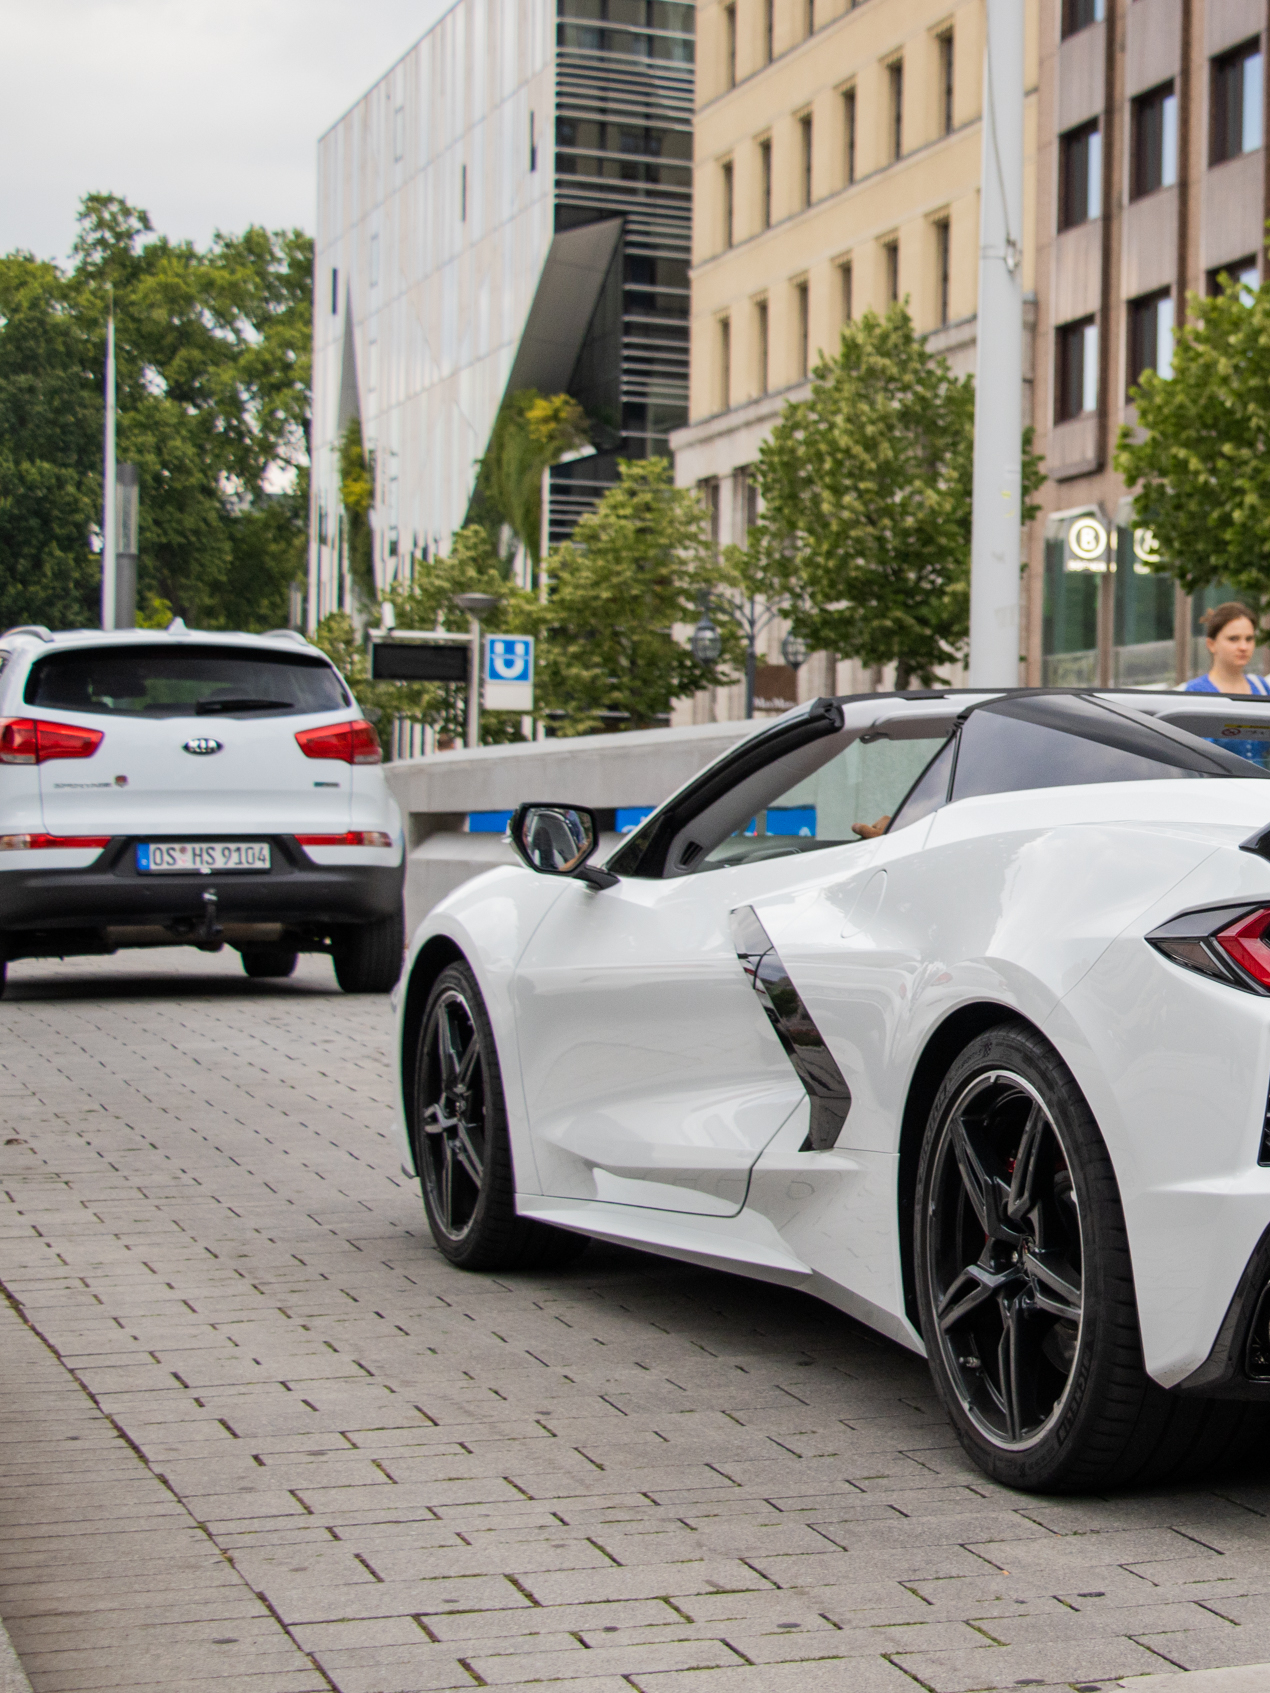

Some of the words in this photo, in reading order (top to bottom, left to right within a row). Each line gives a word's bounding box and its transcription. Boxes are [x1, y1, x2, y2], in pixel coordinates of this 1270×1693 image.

[153, 847, 176, 866] OS
[192, 847, 216, 866] HS
[222, 847, 266, 866] 9104
